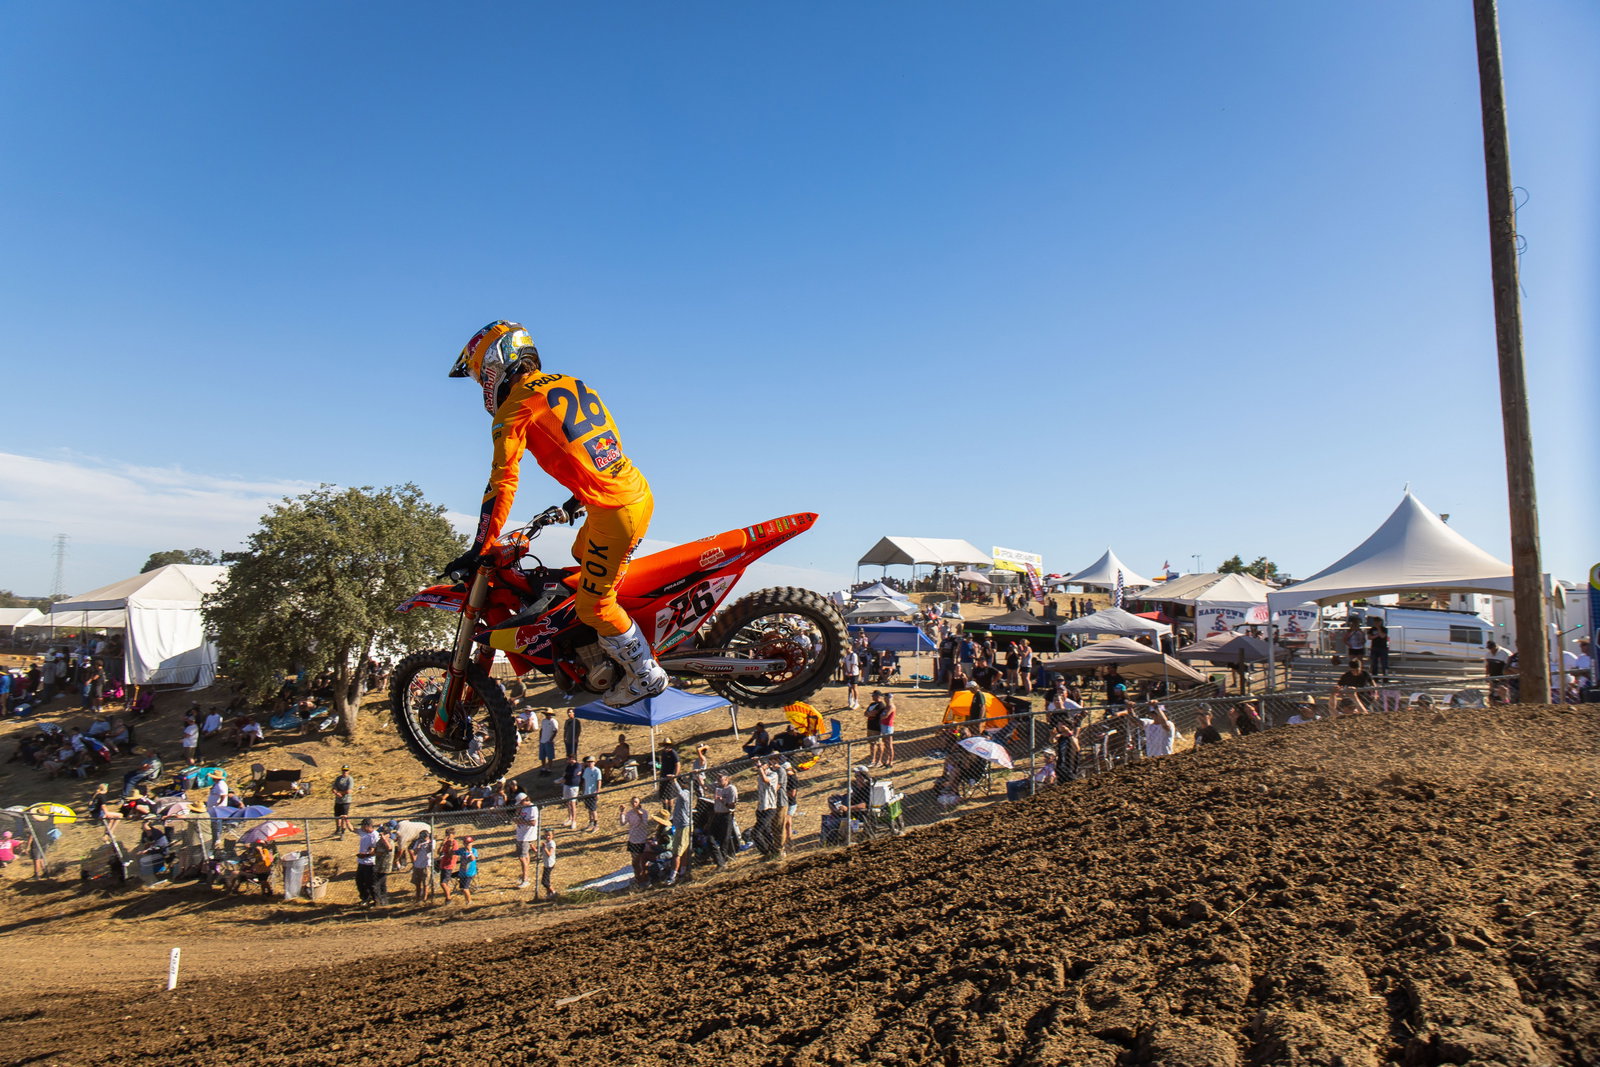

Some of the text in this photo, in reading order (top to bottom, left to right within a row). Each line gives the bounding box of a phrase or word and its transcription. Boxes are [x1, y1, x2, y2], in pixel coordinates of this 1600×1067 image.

[484, 367, 497, 391] Bull
[546, 379, 607, 444] 26
[582, 539, 609, 596] FOX
[663, 578, 686, 592] PRADO
[669, 580, 716, 628] 26
[1198, 608, 1245, 618] HANGTOWN
[1278, 609, 1317, 618] ANGTOWN
[989, 623, 1029, 632] Kawasaki
